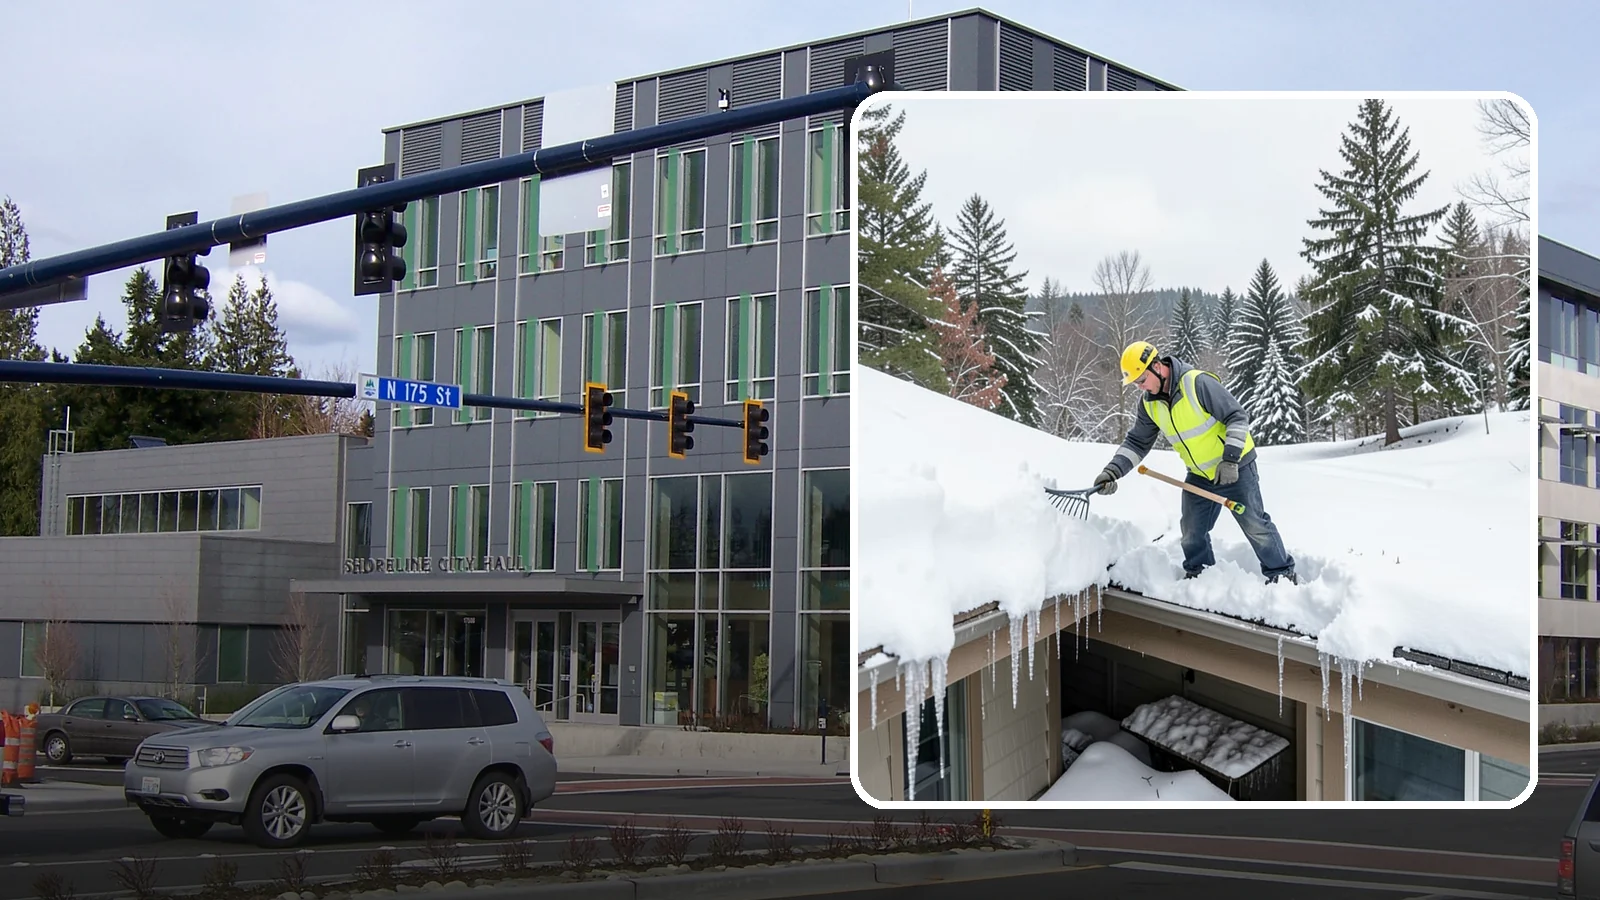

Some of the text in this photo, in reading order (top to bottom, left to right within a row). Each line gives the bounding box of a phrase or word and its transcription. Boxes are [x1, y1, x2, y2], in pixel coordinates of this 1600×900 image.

[387, 380, 451, 406] N 175 St
[344, 555, 526, 574] SHORELINE CITY HALL
